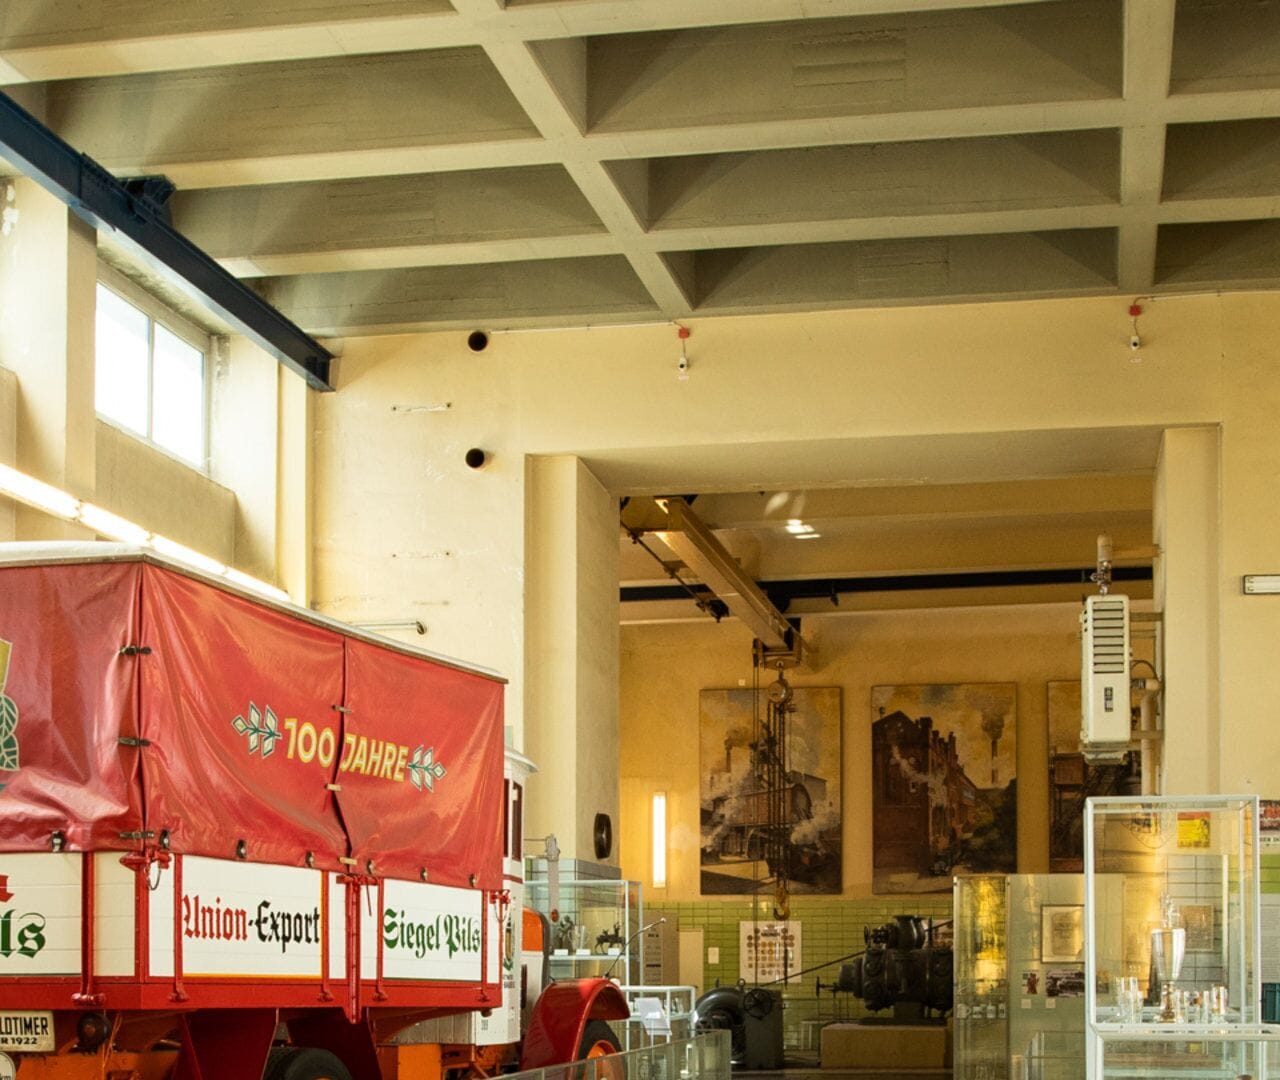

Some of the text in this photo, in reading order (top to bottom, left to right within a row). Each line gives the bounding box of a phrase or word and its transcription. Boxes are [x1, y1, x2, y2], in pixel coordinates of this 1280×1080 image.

[284, 717, 409, 783] 100 JAHRE
[183, 894, 321, 953] Union-Export
[383, 908, 481, 959] Siegel Pils
[12, 1037, 38, 1045] 1922
